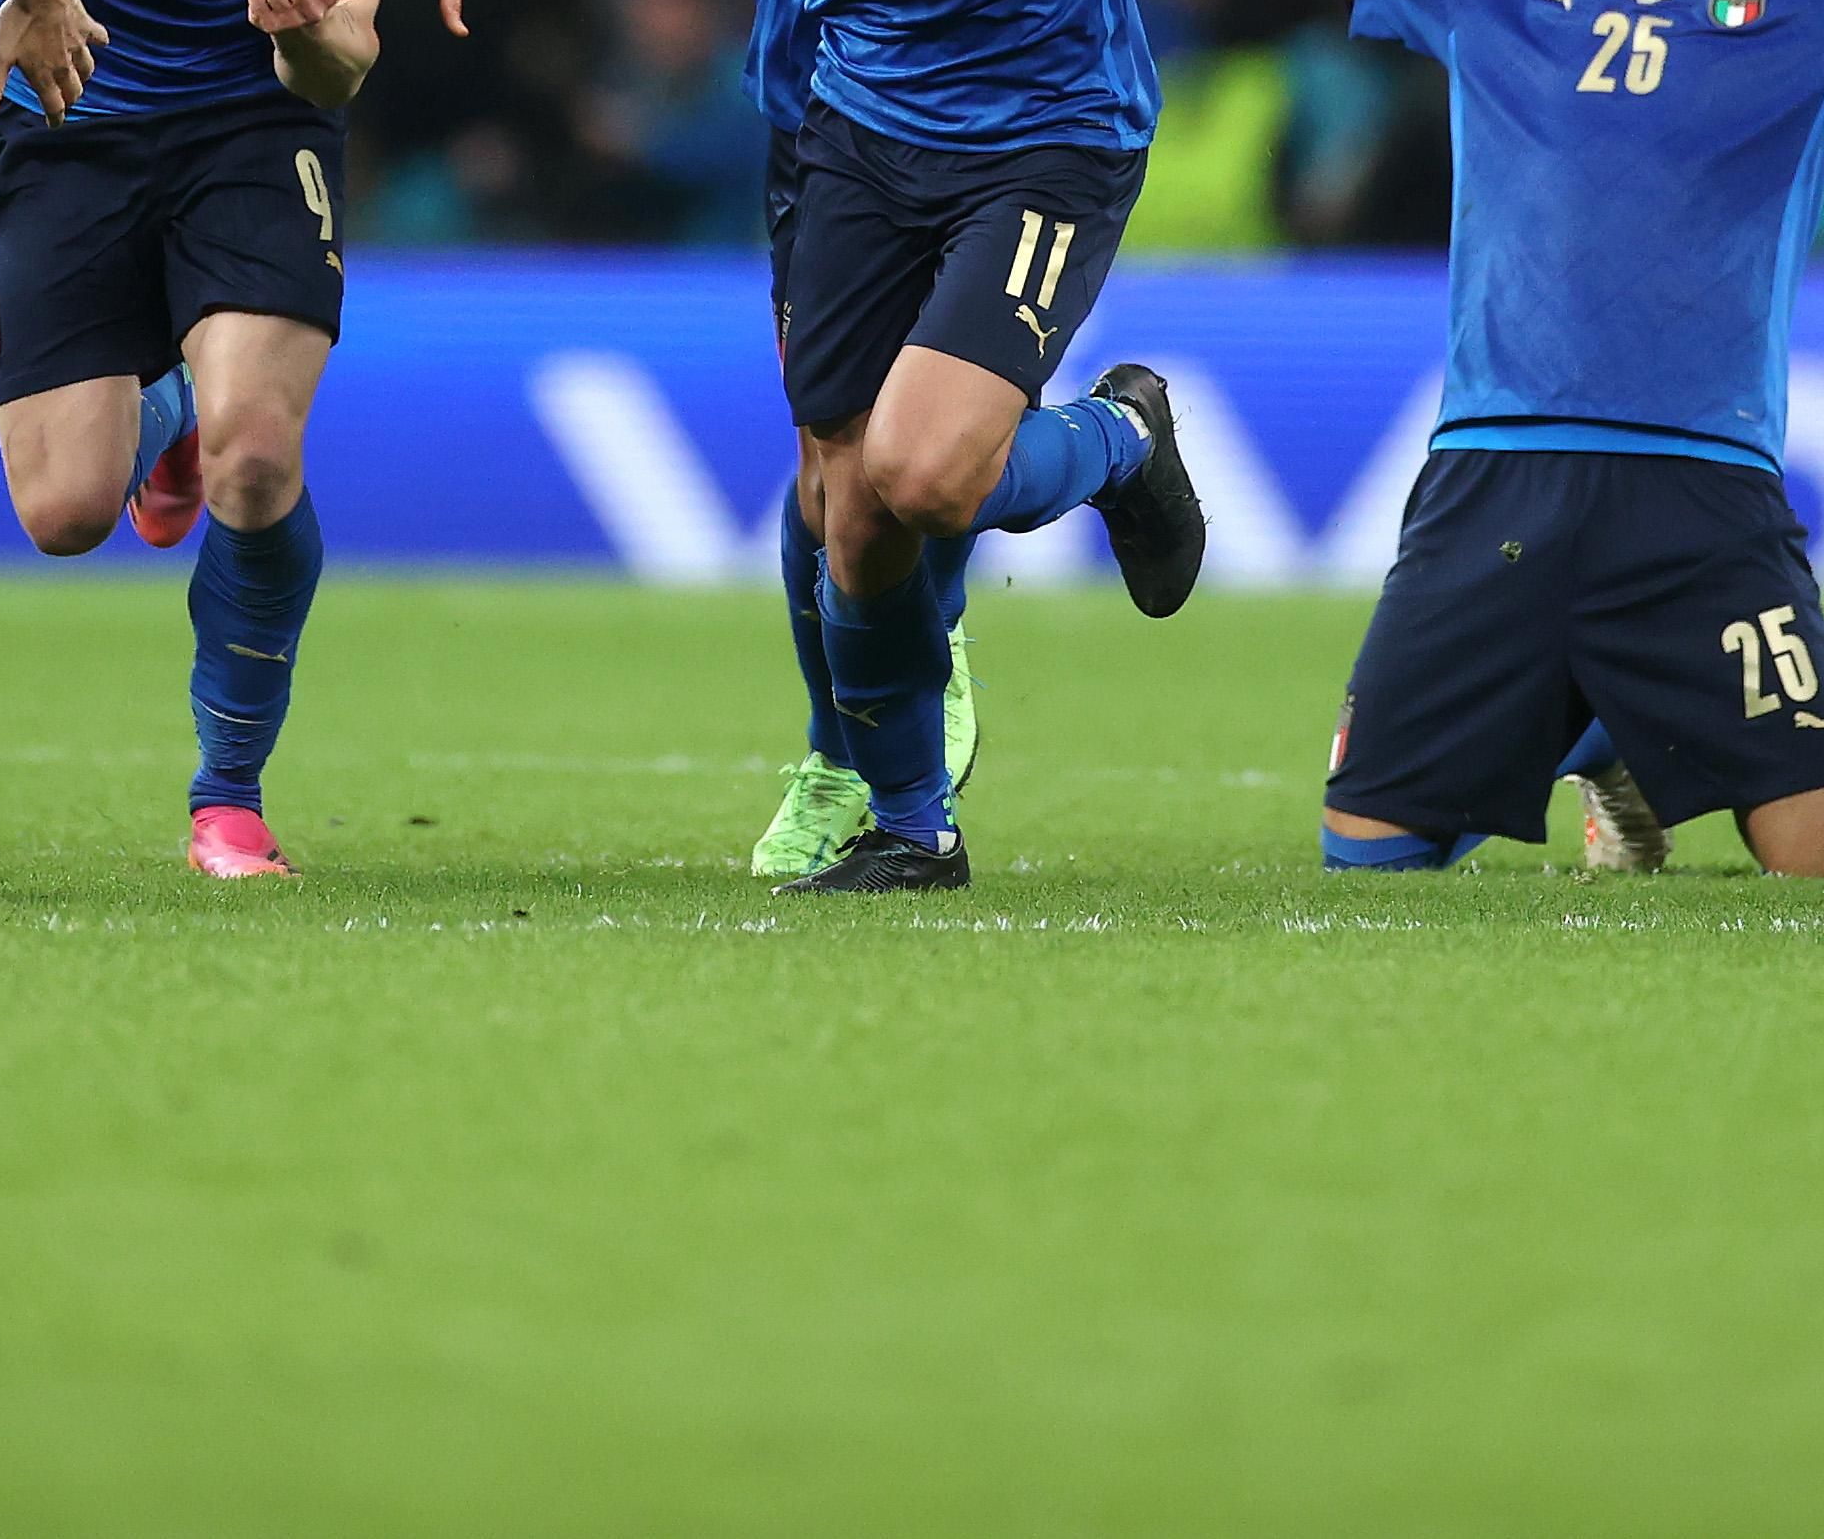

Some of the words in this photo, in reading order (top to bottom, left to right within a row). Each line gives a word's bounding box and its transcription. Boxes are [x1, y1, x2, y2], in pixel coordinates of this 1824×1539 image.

[1577, 12, 1673, 95] 25
[294, 148, 333, 241] 9
[1004, 209, 1076, 310] 11
[1721, 604, 1819, 719] 25
